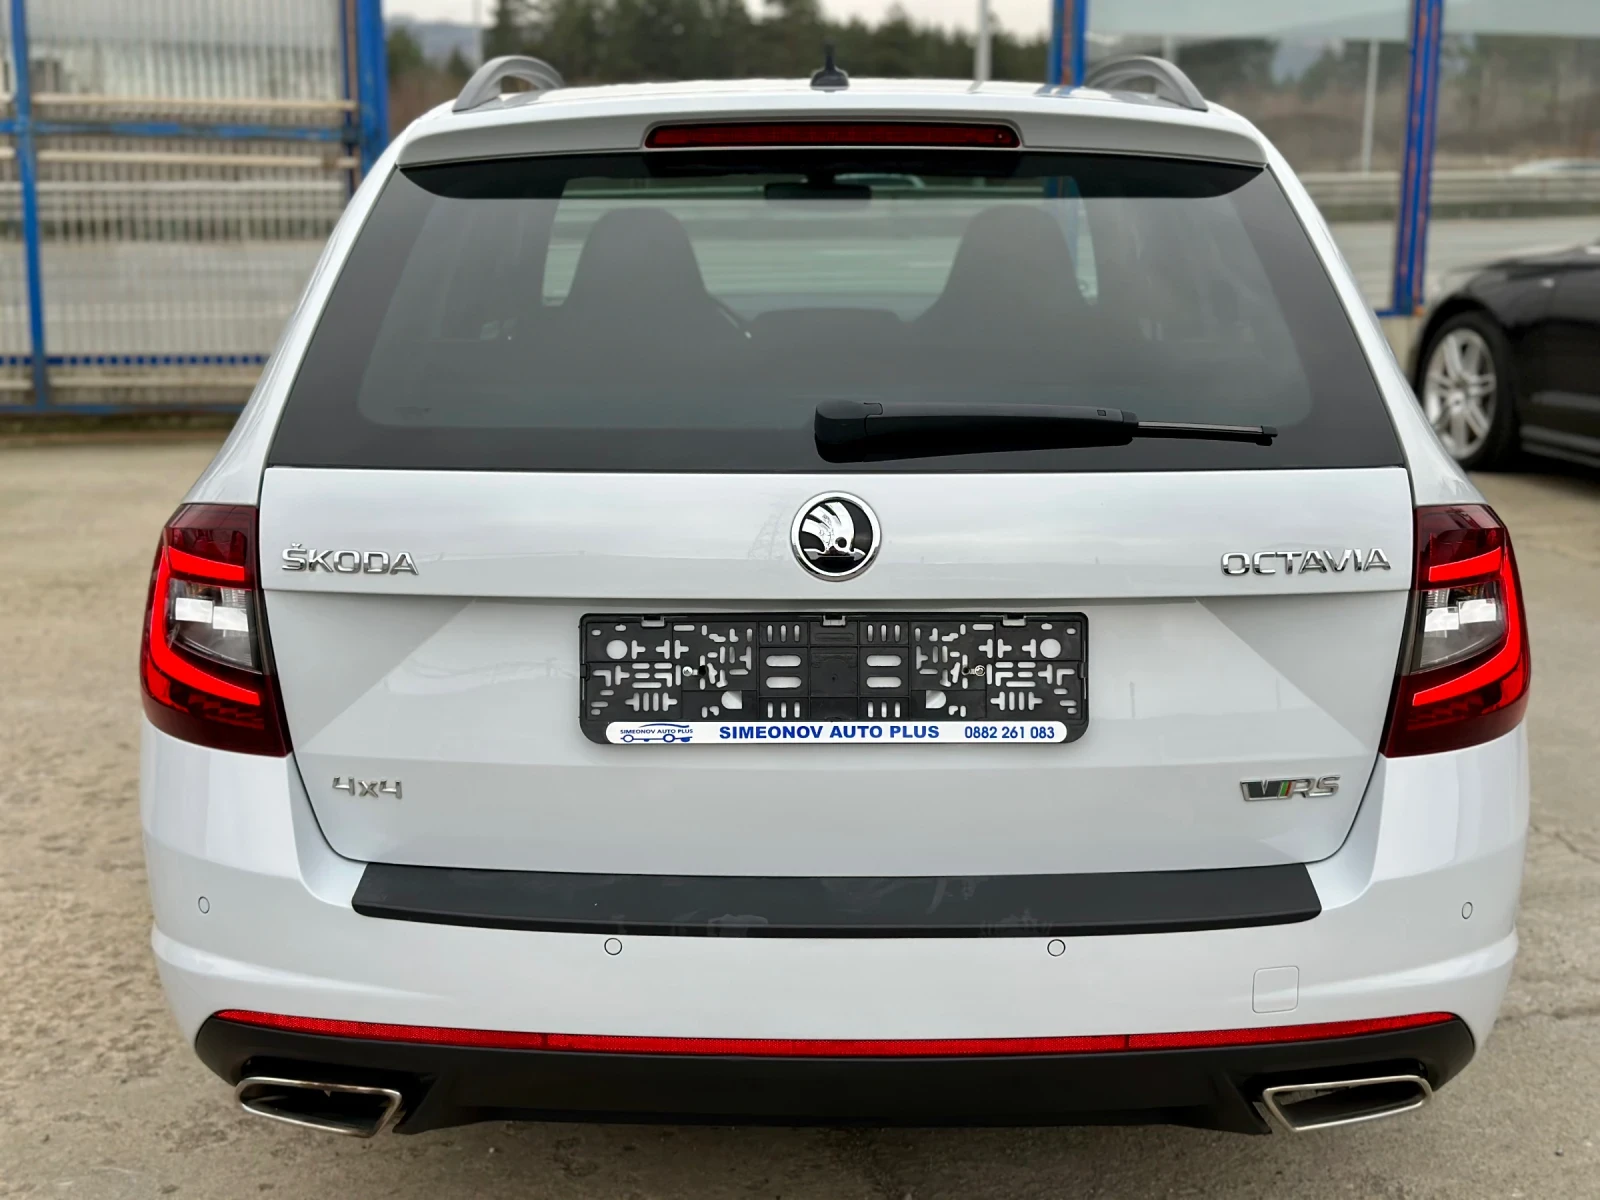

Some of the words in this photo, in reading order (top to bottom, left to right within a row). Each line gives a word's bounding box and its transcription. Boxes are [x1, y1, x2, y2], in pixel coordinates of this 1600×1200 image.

[282, 542, 419, 575] ŠKODA
[1221, 548, 1392, 576] OCTAVIA
[719, 726, 824, 738] SIMEONOV
[829, 726, 883, 738] AUTO
[889, 726, 940, 738] PLUS
[964, 726, 998, 739] 0882
[1001, 726, 1025, 739] 261
[1030, 726, 1055, 739] 083
